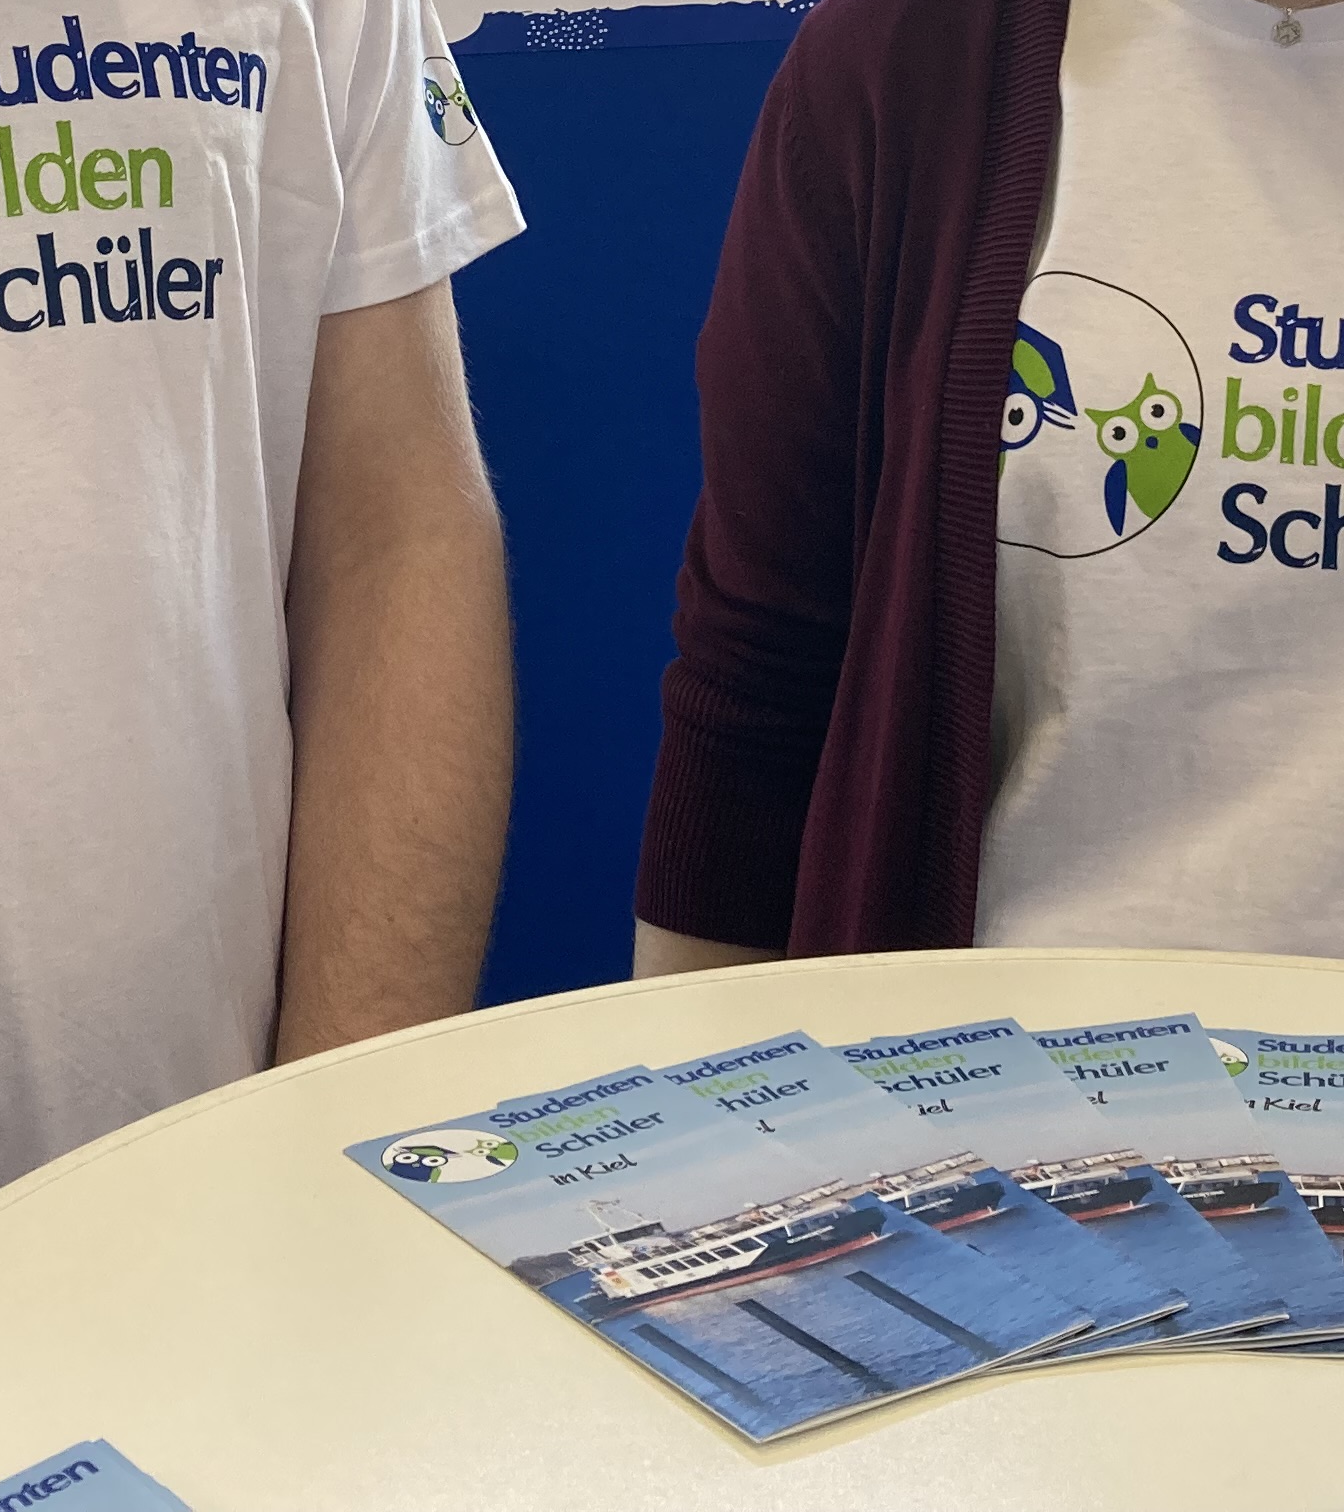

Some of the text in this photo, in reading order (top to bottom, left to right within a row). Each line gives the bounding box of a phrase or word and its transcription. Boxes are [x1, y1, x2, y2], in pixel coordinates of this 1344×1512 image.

[843, 1027, 1014, 1063] Studenten
[489, 1074, 654, 1128] Studenten
[1263, 1097, 1322, 1112] Kiel
[535, 1111, 665, 1158] Schüler
[549, 1153, 638, 1186] in Kiel
